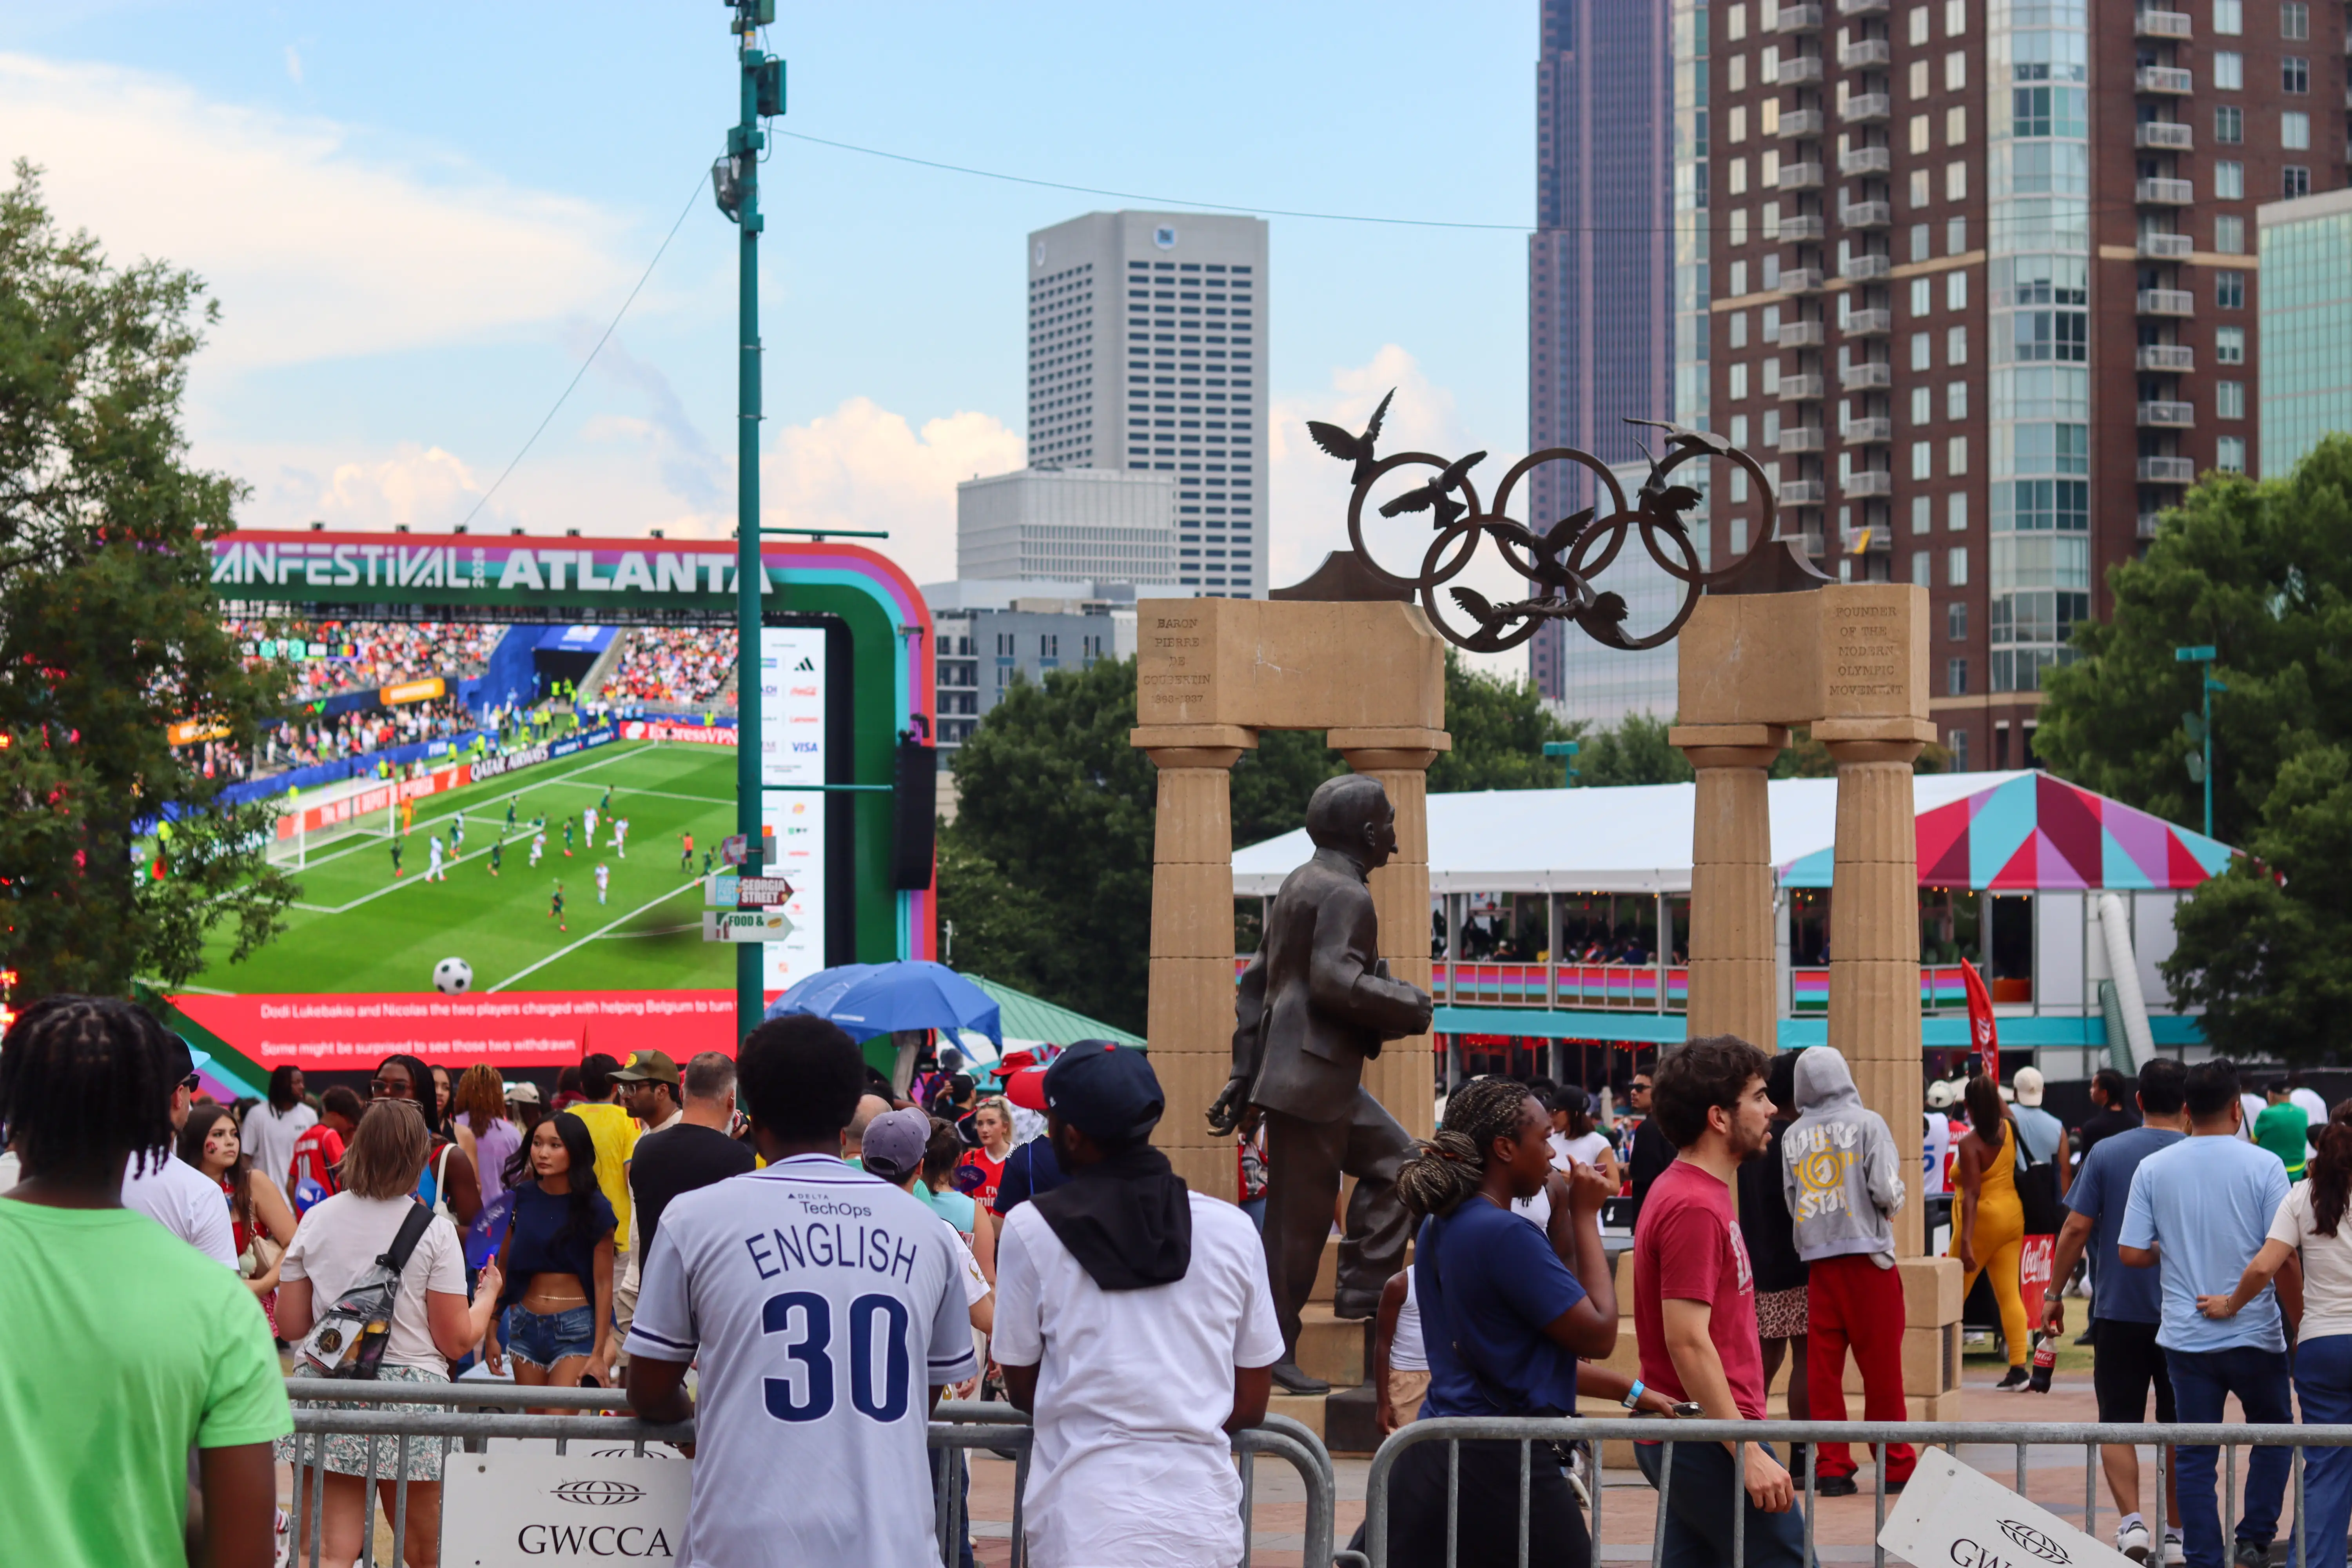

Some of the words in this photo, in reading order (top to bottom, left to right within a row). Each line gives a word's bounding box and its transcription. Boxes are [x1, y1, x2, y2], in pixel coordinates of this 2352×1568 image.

[1836, 607, 1897, 617] FOUNDER
[1157, 619, 1198, 628] BARON
[1840, 627, 1857, 637] OF
[1861, 627, 1887, 637] THE
[1155, 638, 1199, 647] PIERRE
[1838, 646, 1894, 657] MODERN
[1169, 657, 1185, 666] DE
[1838, 666, 1895, 676] OLYMPIC
[1143, 674, 1211, 685] COUBERTIN
[1830, 685, 1904, 696] MOVEMENT
[792, 742, 818, 753] VISA
[470, 758, 506, 782] QATAR
[741, 879, 785, 891] GEORGIA
[742, 891, 778, 904] STREET
[729, 916, 753, 926] FOOD
[756, 916, 764, 926] &
[358, 1004, 380, 1018] and
[383, 1004, 427, 1018] Nicolas
[430, 1003, 450, 1016] the
[452, 1004, 474, 1016] two
[477, 1002, 520, 1018] players
[522, 1002, 571, 1017] charged
[574, 1001, 597, 1014] with
[600, 1000, 644, 1016] helping
[646, 1000, 693, 1015] Belgium
[695, 1001, 707, 1013] to
[709, 1001, 733, 1012] turn
[261, 1042, 299, 1056] Some
[302, 1041, 334, 1058] might
[337, 1040, 353, 1054] be
[355, 1040, 411, 1057] surprised
[414, 1040, 426, 1054] to
[429, 1042, 450, 1054] see
[452, 1040, 486, 1053] those
[489, 1040, 510, 1052] two
[513, 1038, 576, 1051] withdrawn
[803, 1201, 872, 1219] TechOps
[746, 1223, 918, 1284] ENGLISH
[761, 1291, 910, 1425] 30
[518, 1524, 673, 1557] GWCCA
